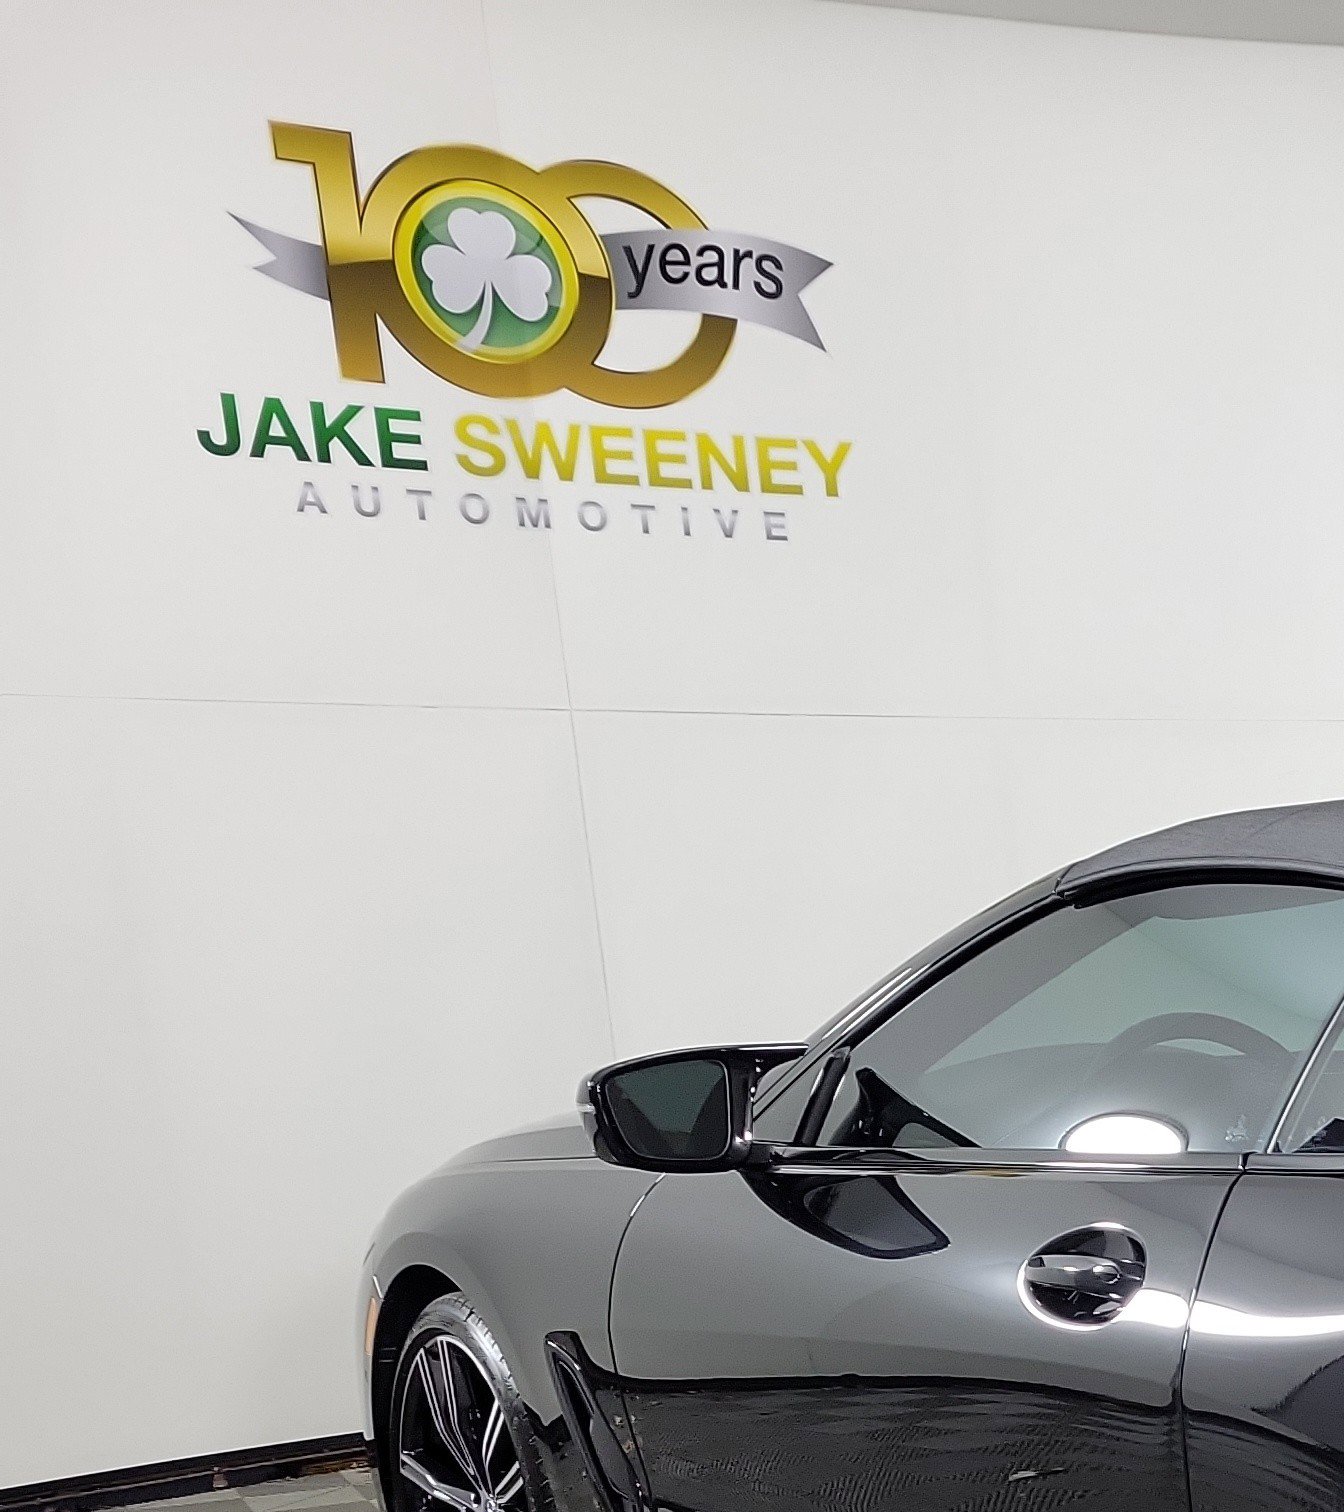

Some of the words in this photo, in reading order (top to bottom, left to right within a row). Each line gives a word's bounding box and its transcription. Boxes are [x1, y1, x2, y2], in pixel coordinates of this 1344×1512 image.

[267, 119, 739, 410] 100
[621, 236, 785, 300] years
[196, 391, 429, 472] JAKE
[453, 413, 852, 498] SWEENEY
[296, 481, 790, 542] AUTOMOTIVE
